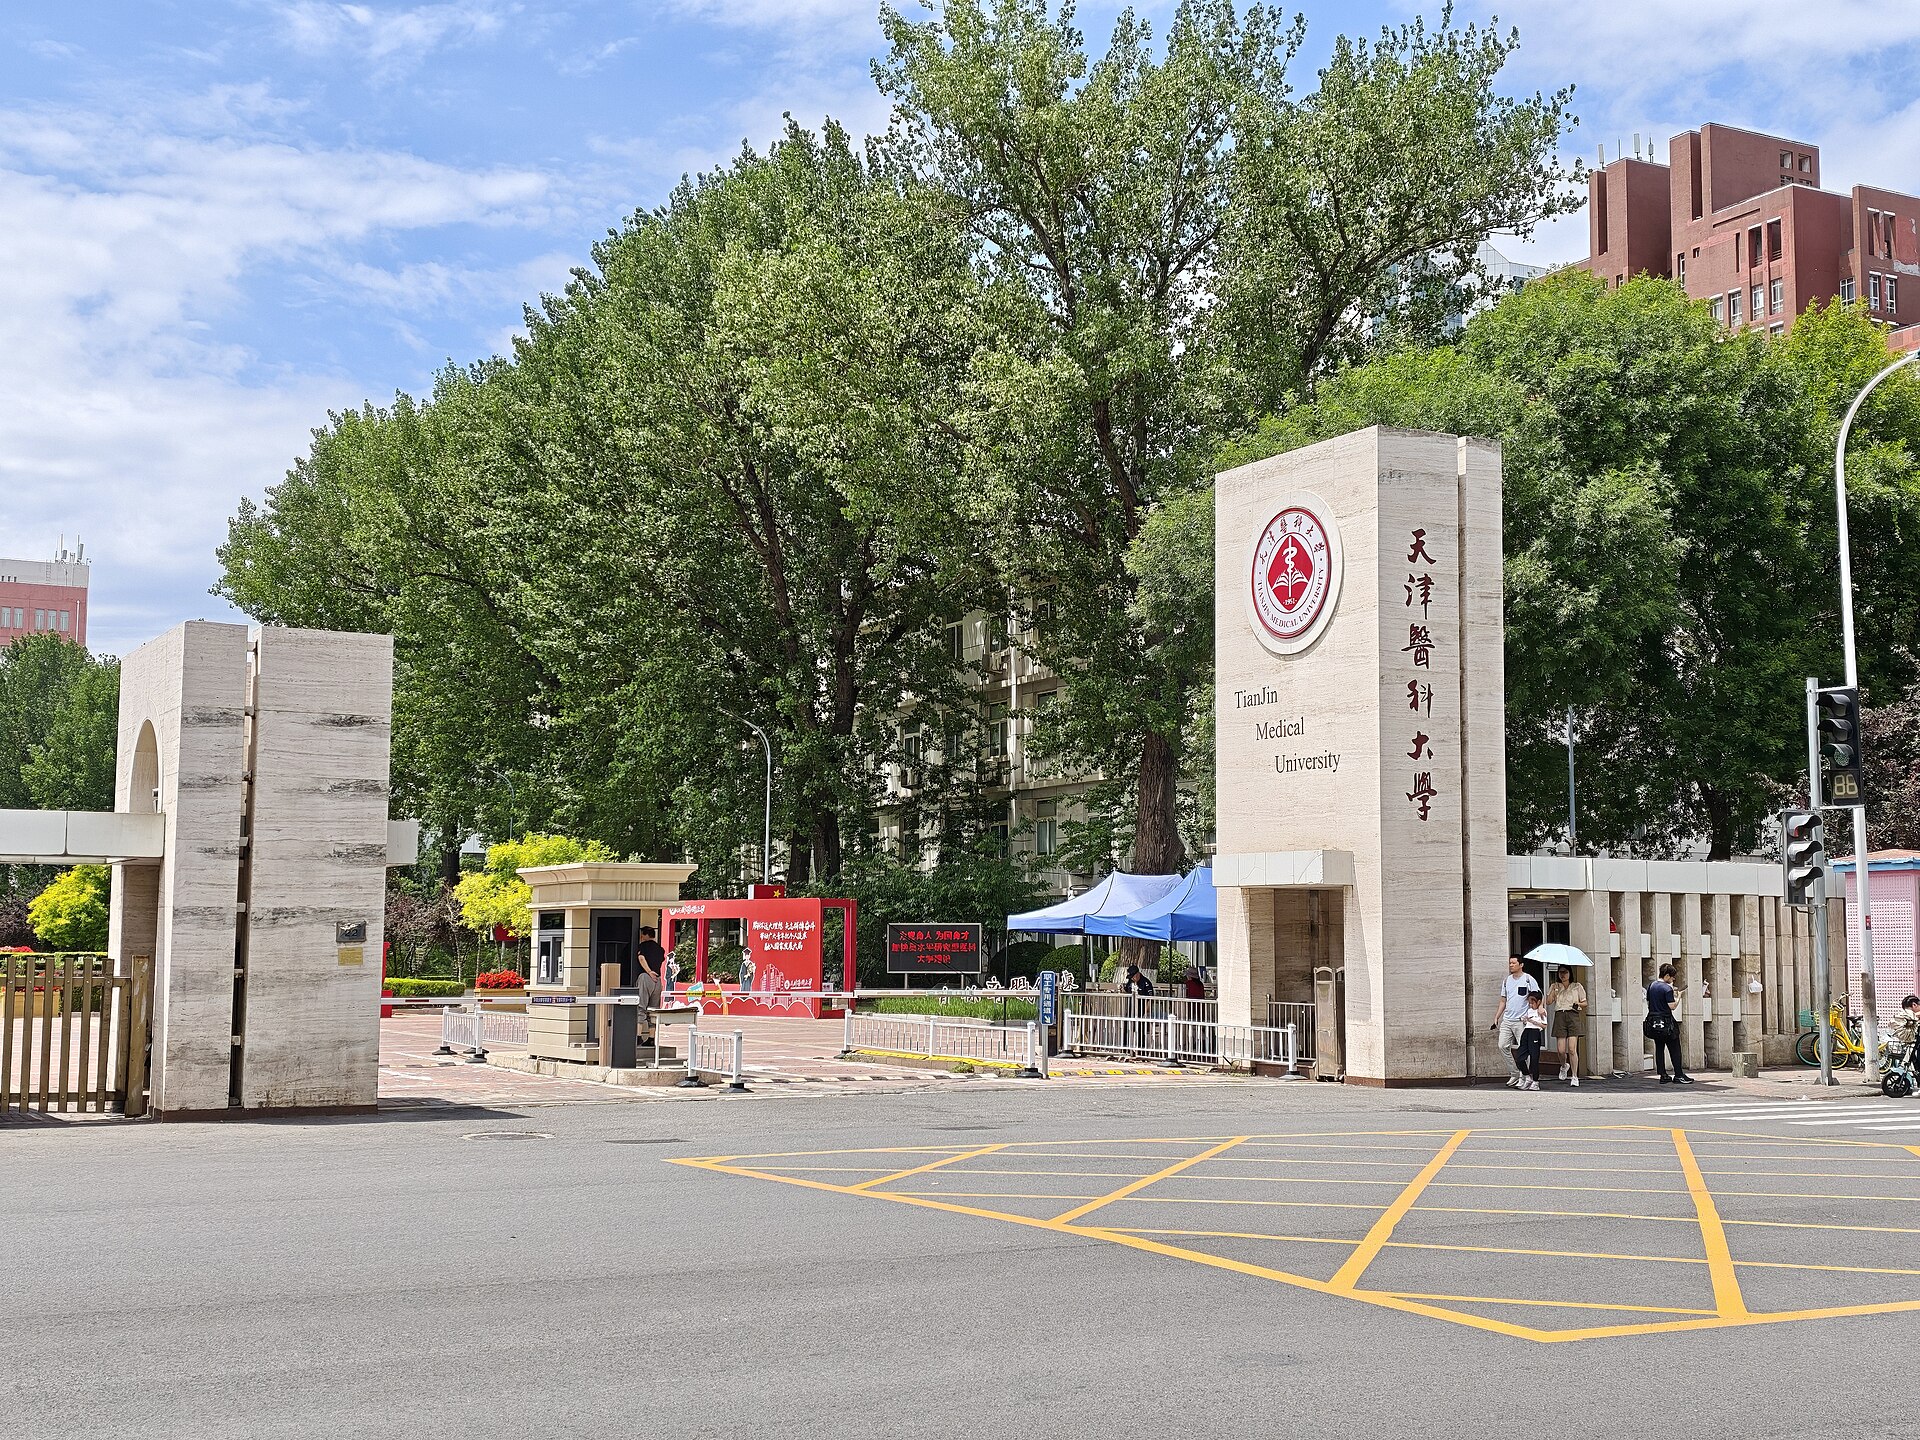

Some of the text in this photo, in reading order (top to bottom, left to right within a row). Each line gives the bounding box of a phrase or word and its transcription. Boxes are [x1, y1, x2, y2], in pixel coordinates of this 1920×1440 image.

[1257, 567, 1325, 629] TIANJIN MEDICAL UNIVERSITY
[1234, 686, 1279, 709] TianJin
[1255, 716, 1305, 741] Medical
[1275, 750, 1341, 775] University
[1043, 973, 1053, 1014] 职工专用通道
